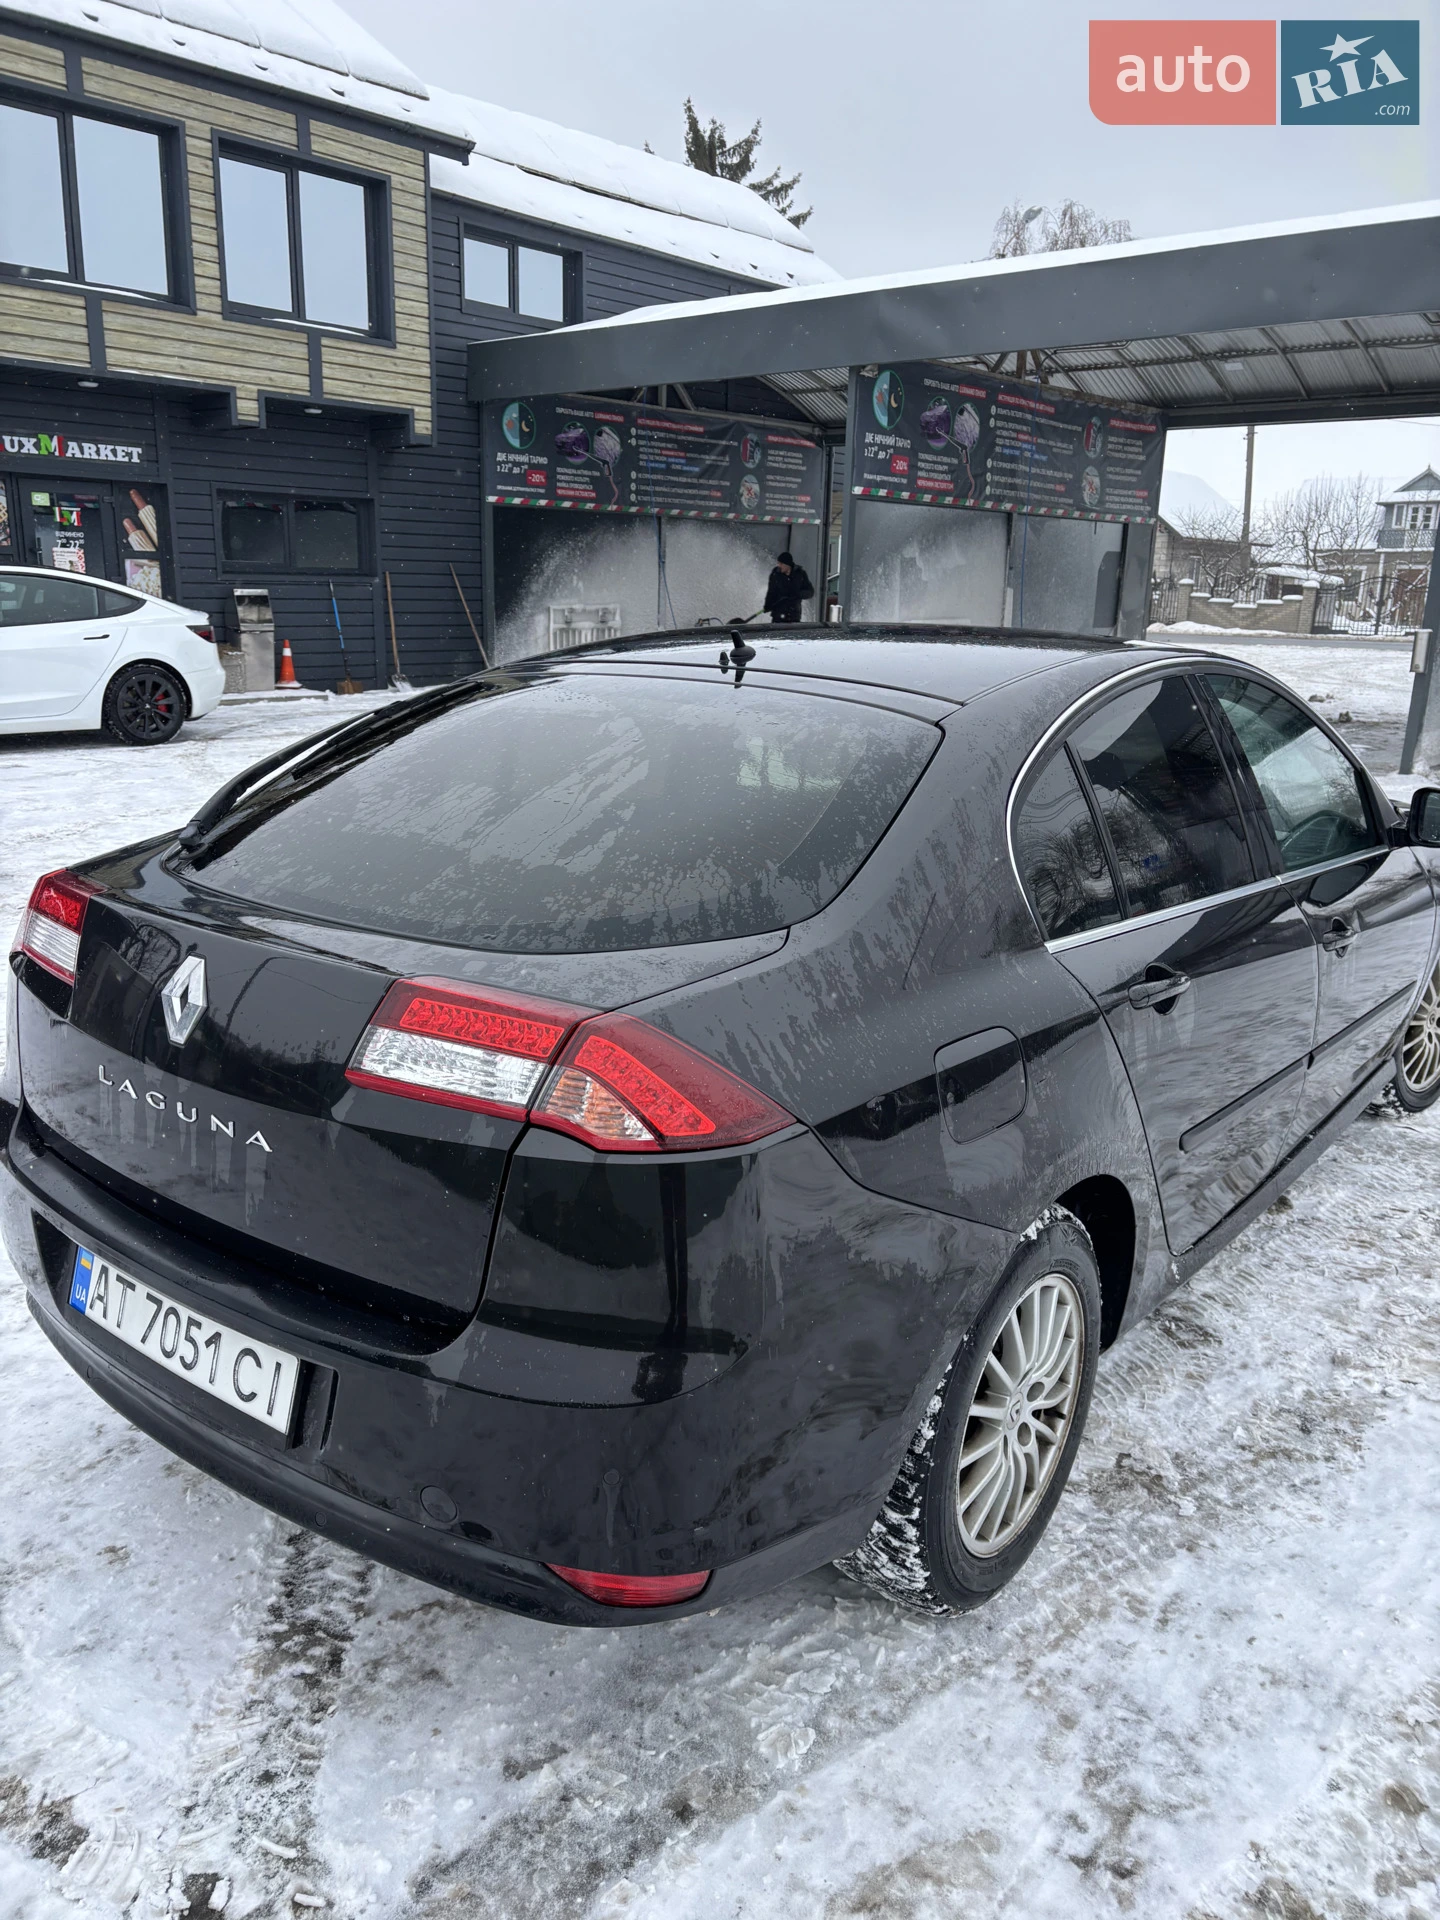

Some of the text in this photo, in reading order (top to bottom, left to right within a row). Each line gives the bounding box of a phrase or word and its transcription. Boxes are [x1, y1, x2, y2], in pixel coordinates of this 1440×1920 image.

[893, 460, 908, 471] -20%
[528, 473, 545, 483] -20%
[98, 1064, 272, 1153] LAGUNA
[75, 1283, 88, 1305] UA
[88, 1264, 282, 1417] AT 7051 CI
